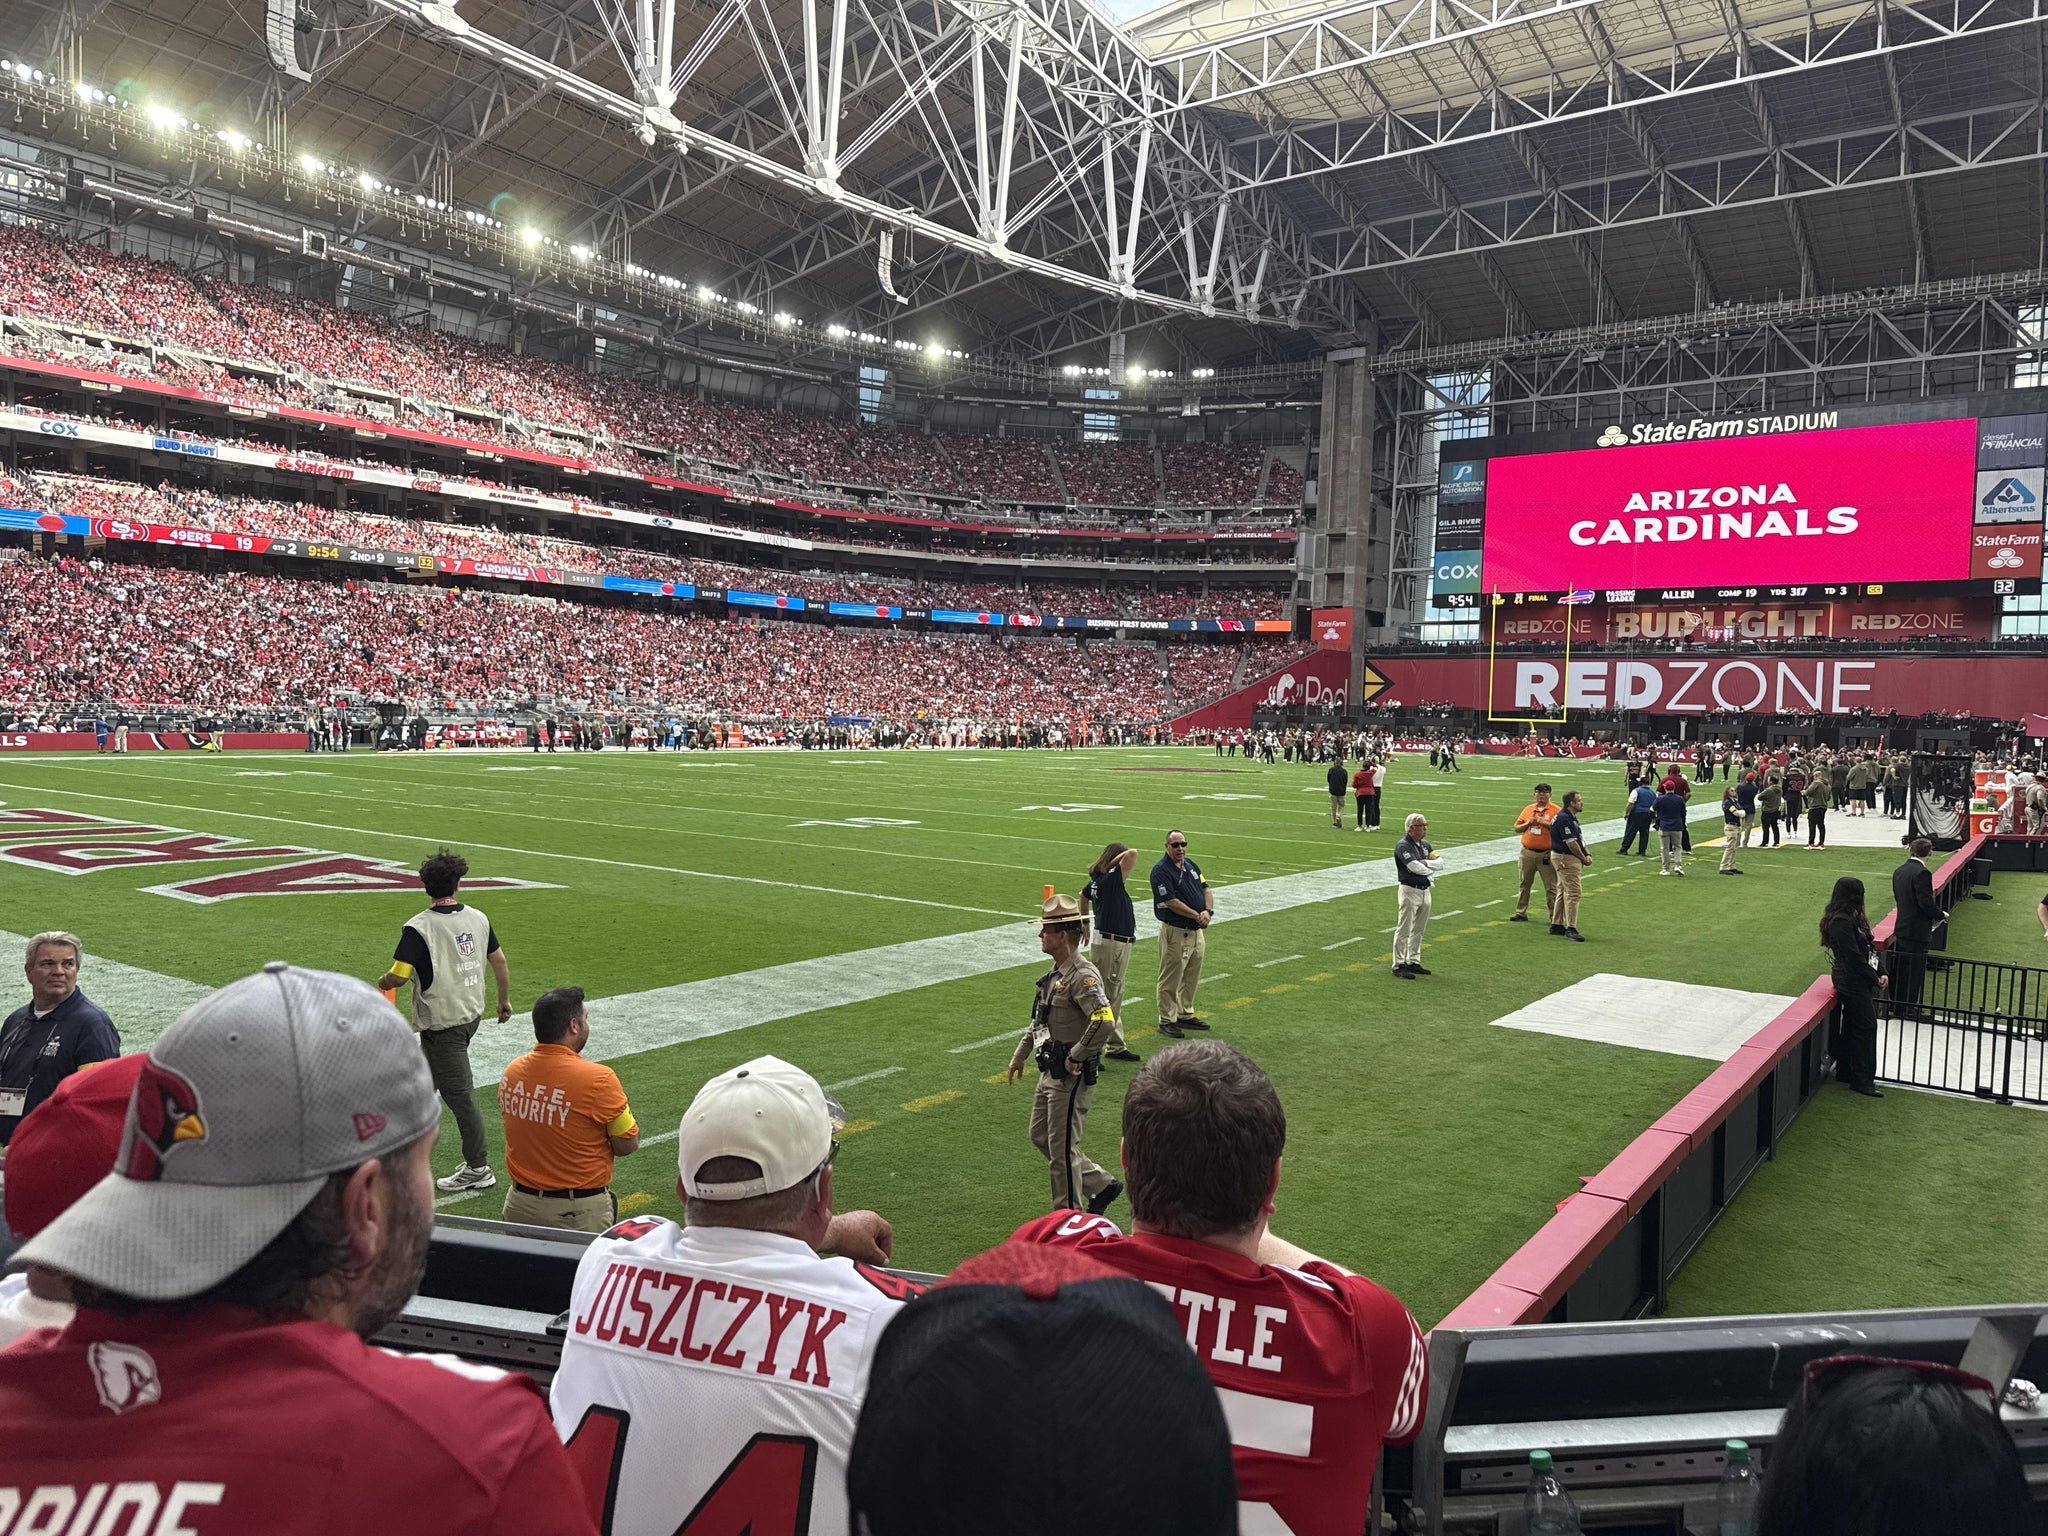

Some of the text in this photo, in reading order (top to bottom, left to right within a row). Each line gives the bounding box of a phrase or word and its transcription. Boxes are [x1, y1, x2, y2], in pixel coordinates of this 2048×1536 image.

[217, 395, 235, 405] PAT
[240, 400, 280, 412] TILLMAN
[40, 421, 78, 437] COX
[1746, 411, 1839, 435] STADIUM
[1982, 432, 2014, 441] desert
[154, 438, 215, 457] BUD LIGHT
[1623, 483, 1797, 513] ARIZONA
[1981, 505, 2035, 515] Albertsons
[1568, 506, 1859, 546] CARDINALS
[169, 529, 253, 550] 49ERS 19
[287, 543, 297, 555] 2
[307, 545, 339, 559] 9:54
[403, 556, 415, 565] 24
[420, 558, 433, 567] 32
[453, 561, 529, 577] 7 CARDINALS
[1437, 564, 1479, 580] COX
[1769, 587, 1808, 597] YDS 317
[1824, 586, 1847, 595] TD 3
[1996, 581, 2013, 592] 32
[1606, 589, 1636, 597] PASSING
[1661, 589, 1695, 600] ALLEN
[1717, 588, 1757, 598] COMP 19
[1448, 594, 1474, 606] 9:54
[1057, 617, 1064, 627] 2
[1087, 619, 1169, 629] RUSHING FIRST DOWNS
[1190, 620, 1198, 631] 3
[1615, 610, 1693, 638] BUD
[1979, 818, 1993, 833] G
[459, 942, 474, 954] NFL
[575, 1263, 847, 1388] JUSZCZYK
